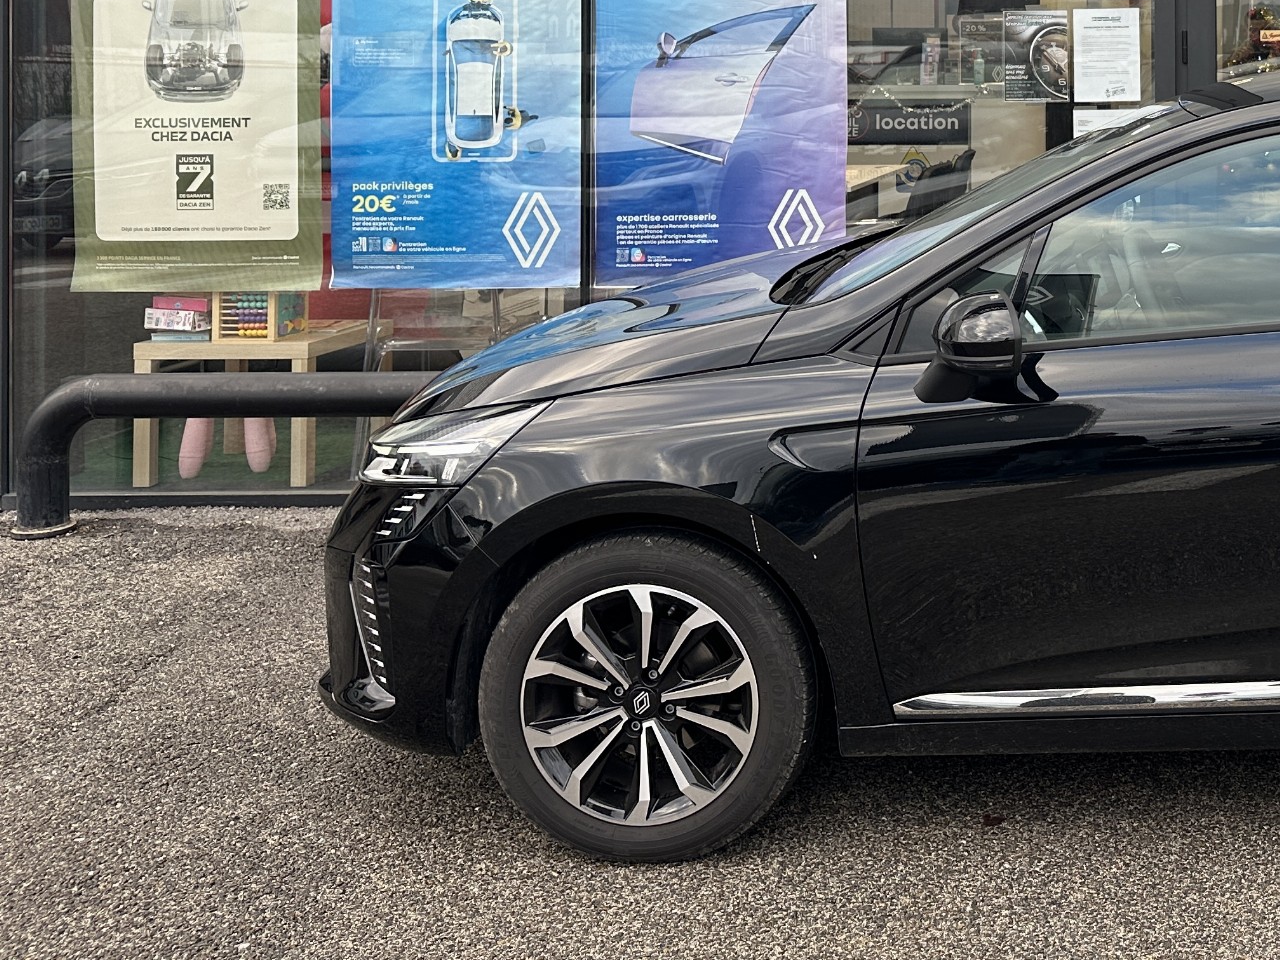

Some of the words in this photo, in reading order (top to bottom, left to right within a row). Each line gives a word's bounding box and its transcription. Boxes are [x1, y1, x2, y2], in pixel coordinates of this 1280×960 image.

[134, 117, 251, 129] EXCLUSIVEMENT
[875, 113, 959, 130] location
[151, 130, 187, 142] CHEZ
[190, 130, 233, 142] DACIA
[179, 155, 211, 163] JUSQU'À
[352, 181, 380, 193] pack
[380, 181, 434, 193] privilèges
[616, 214, 661, 224] expertise
[662, 213, 717, 222] carrosserie
